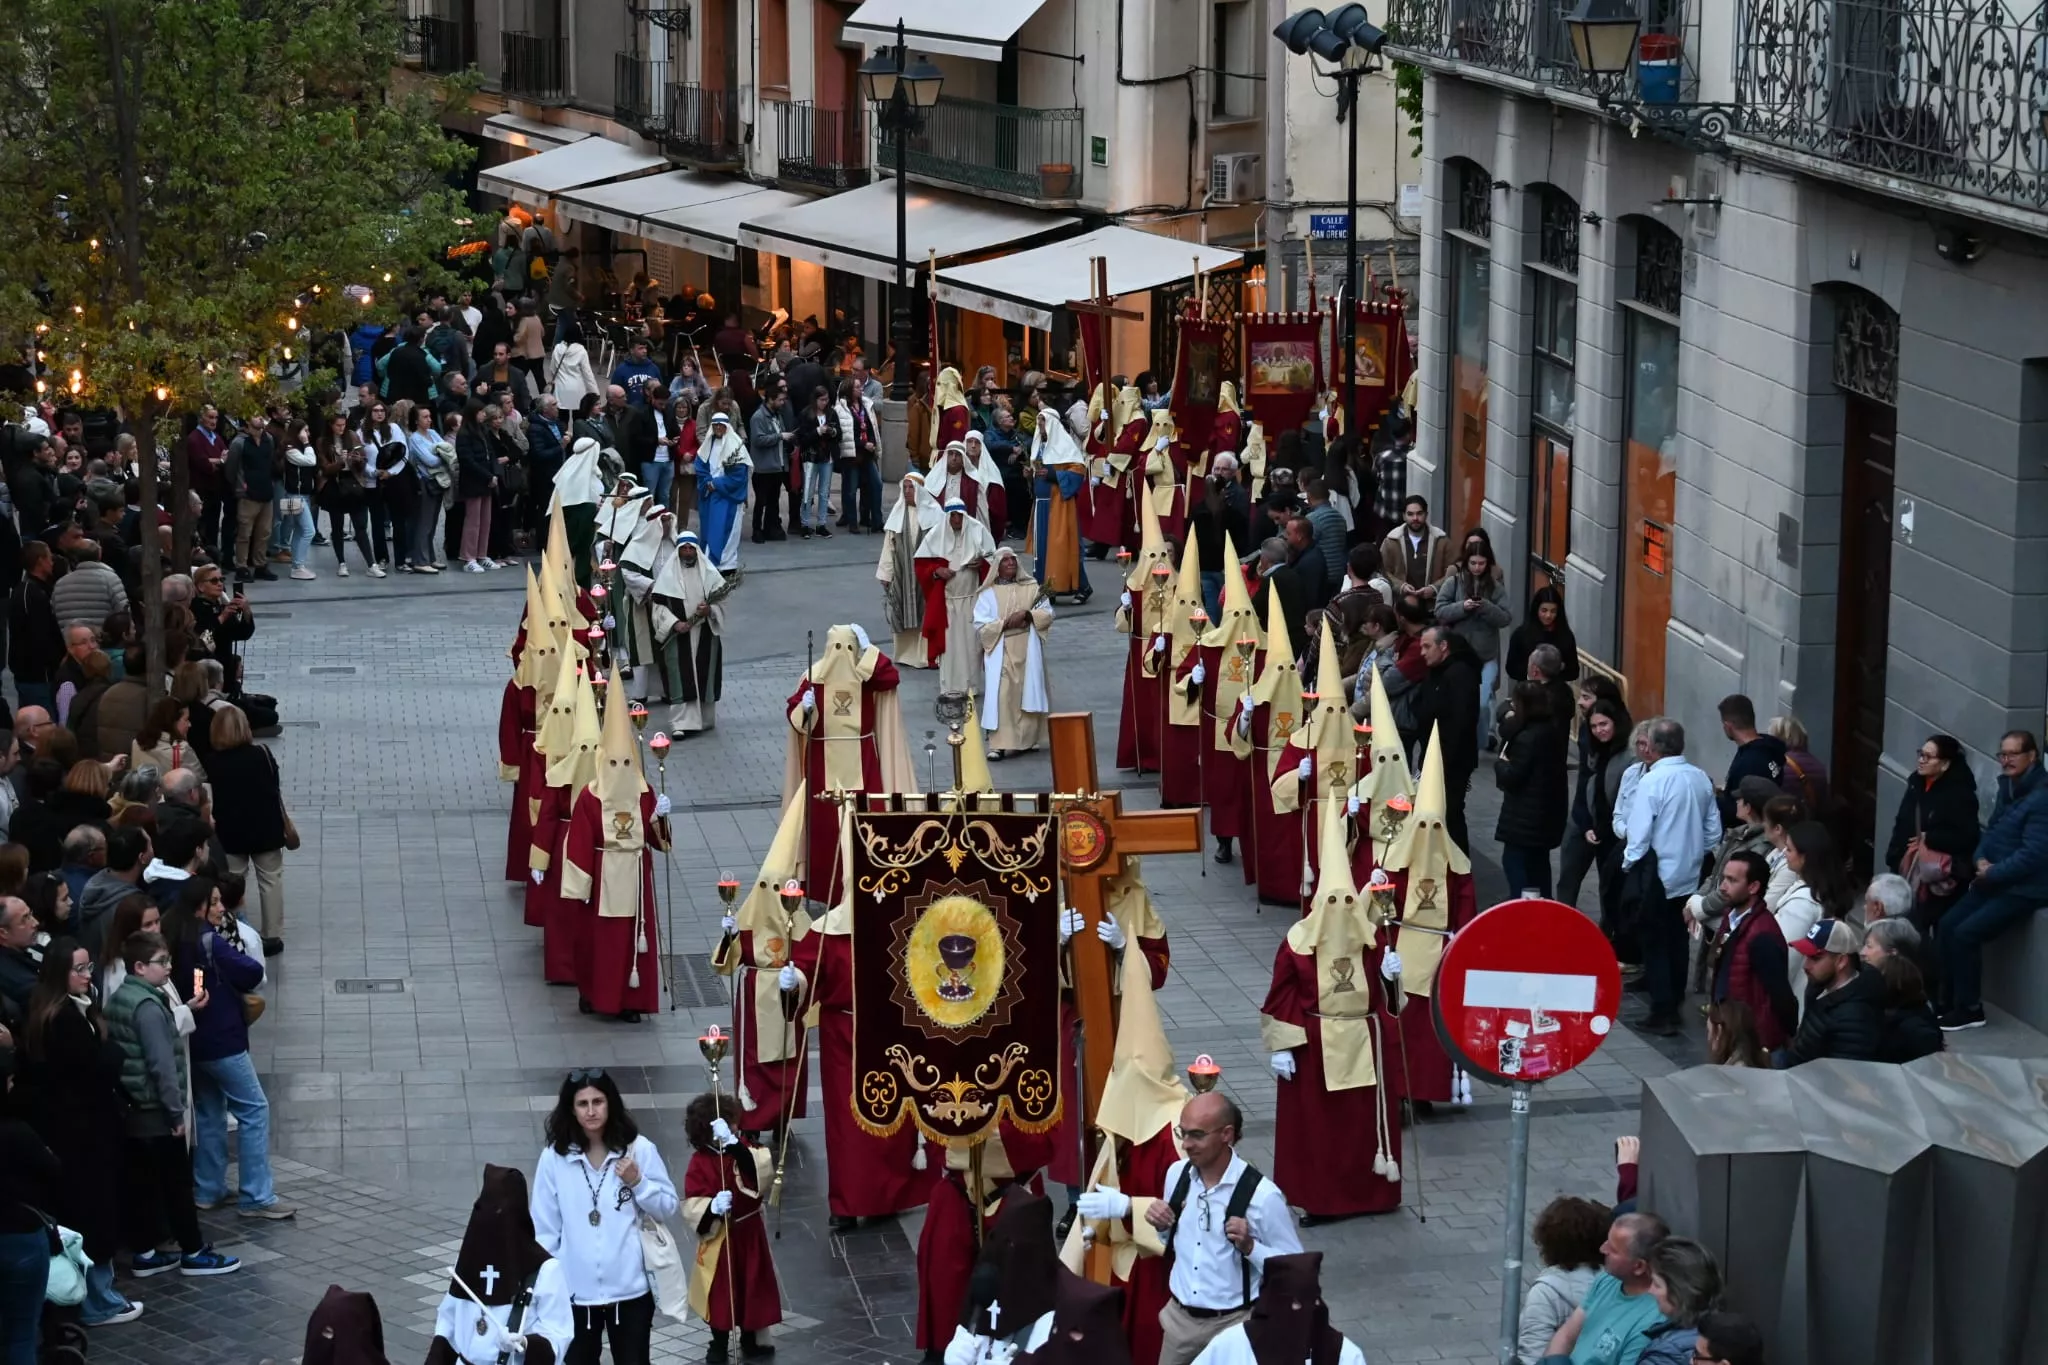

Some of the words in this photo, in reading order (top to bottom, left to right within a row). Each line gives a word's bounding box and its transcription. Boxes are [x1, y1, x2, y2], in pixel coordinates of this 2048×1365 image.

[1321, 216, 1344, 224] CALLE
[1311, 230, 1325, 239] SAN
[1326, 230, 1348, 239] ORENC
